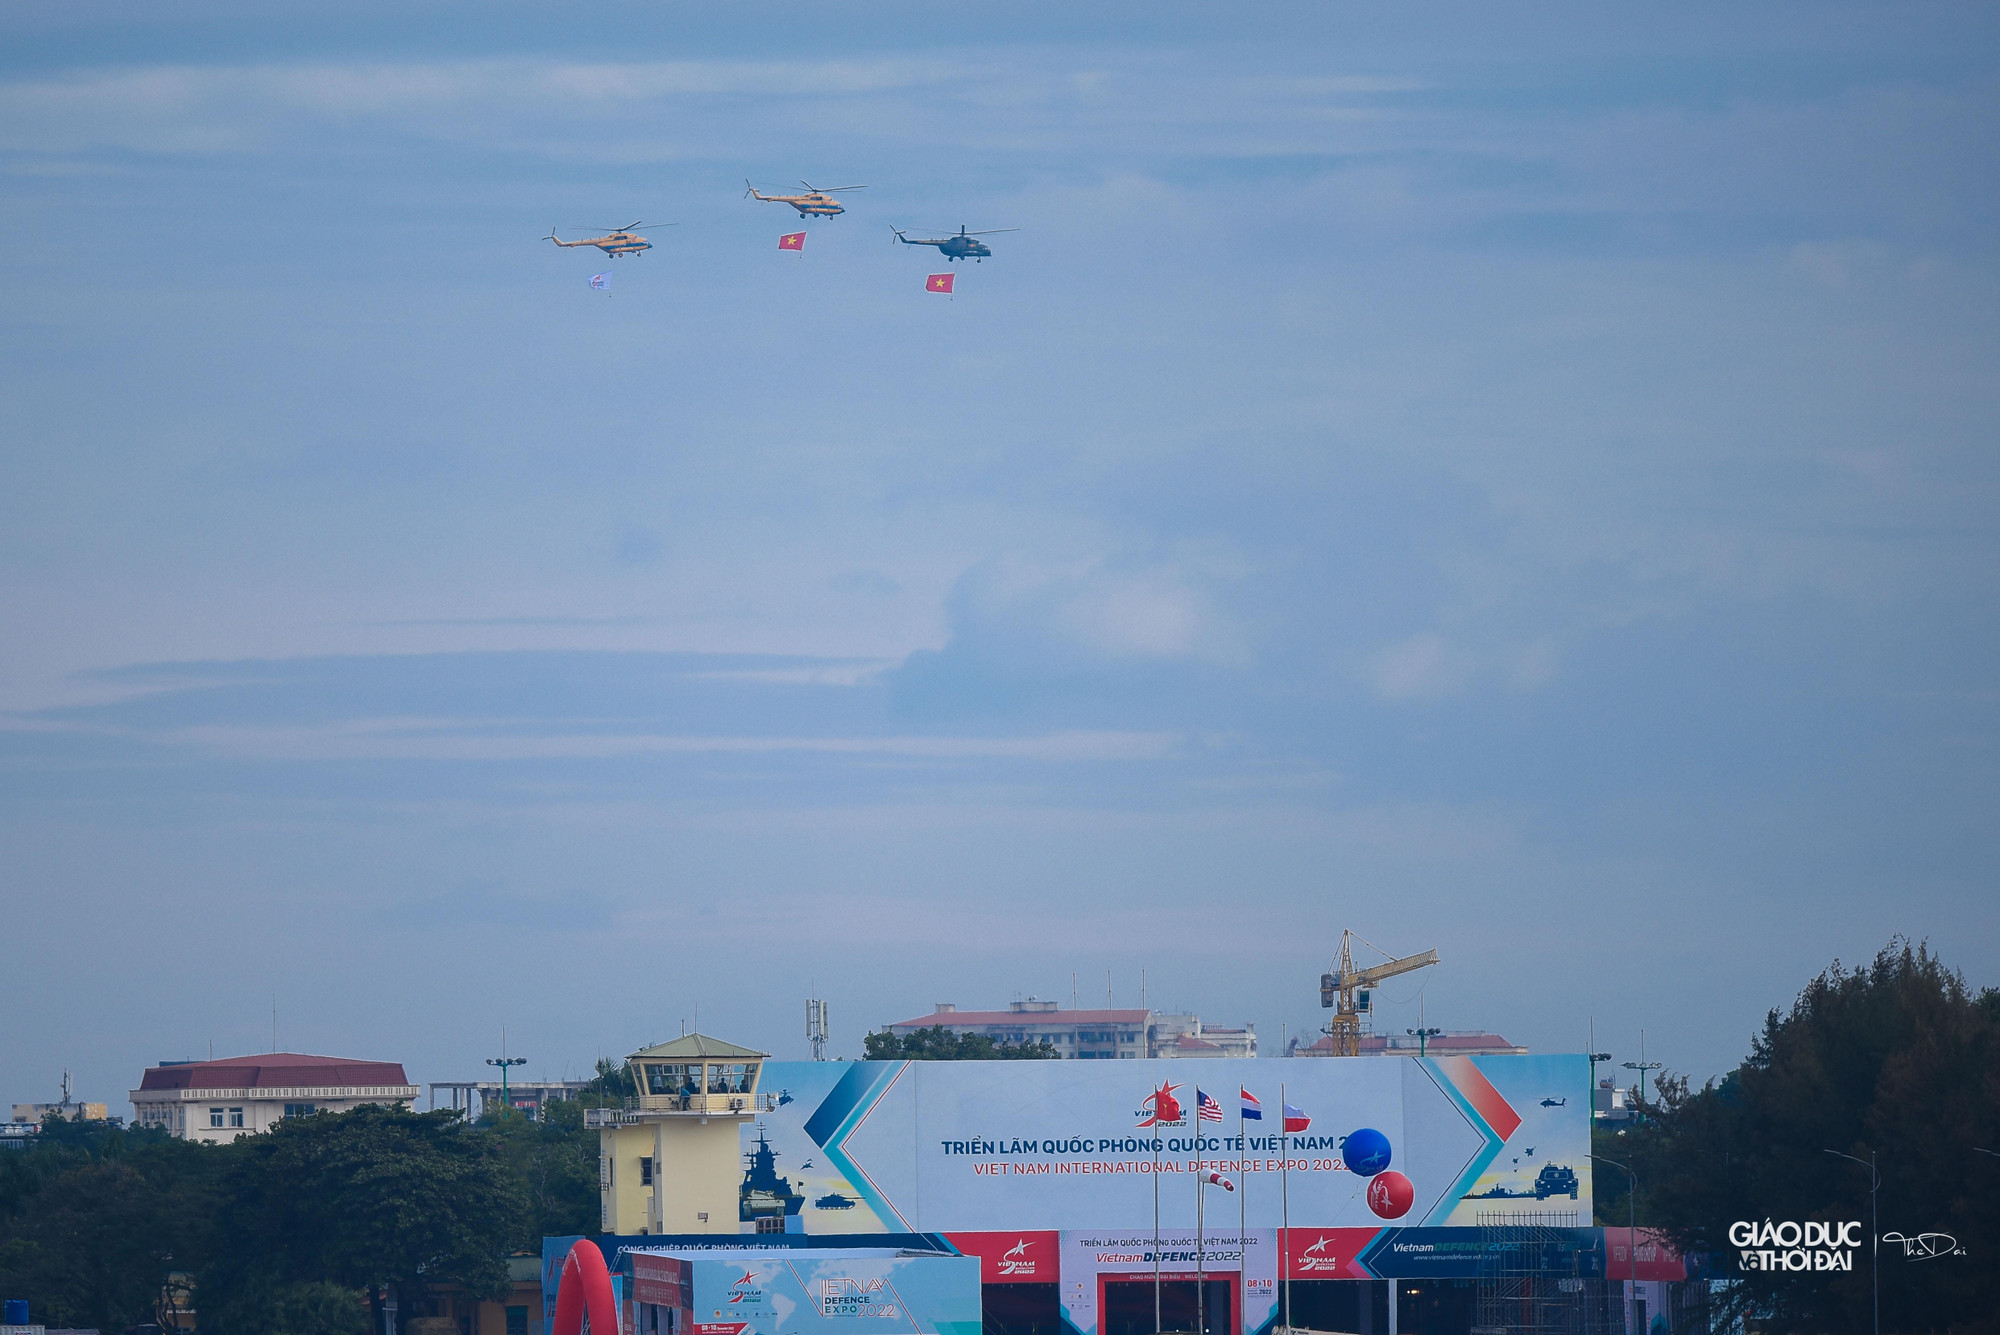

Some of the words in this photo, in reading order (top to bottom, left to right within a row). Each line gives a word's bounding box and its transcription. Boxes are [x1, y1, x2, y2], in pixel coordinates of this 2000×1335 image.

[941, 1134, 995, 1155] TRIỂN
[999, 1137, 1038, 1154] LÃM
[1042, 1134, 1095, 1154] QUỐC
[1099, 1135, 1164, 1153] PHÒNG
[1168, 1132, 1220, 1153] QUỐC
[1223, 1132, 1245, 1151] TẾ
[1249, 1133, 1289, 1154] VIỆT
[1293, 1136, 1334, 1150] NAM
[974, 1163, 1010, 1175] VIET
[1014, 1163, 1050, 1174] NAM
[1055, 1161, 1184, 1174] INTERNATIONAL
[1188, 1160, 1262, 1173] DEFENCE
[1266, 1160, 1309, 1172] EXPO
[1120, 1237, 1142, 1246] QUỐC
[1171, 1237, 1192, 1246] QUỐC
[1203, 1237, 1220, 1247] VIỆT
[1247, 1279, 1258, 1288] 08
[1262, 1279, 1273, 1288] 10
[824, 1296, 870, 1305] DEFENCE
[825, 1305, 857, 1314] EXPO
[857, 1303, 895, 1317] 2022
